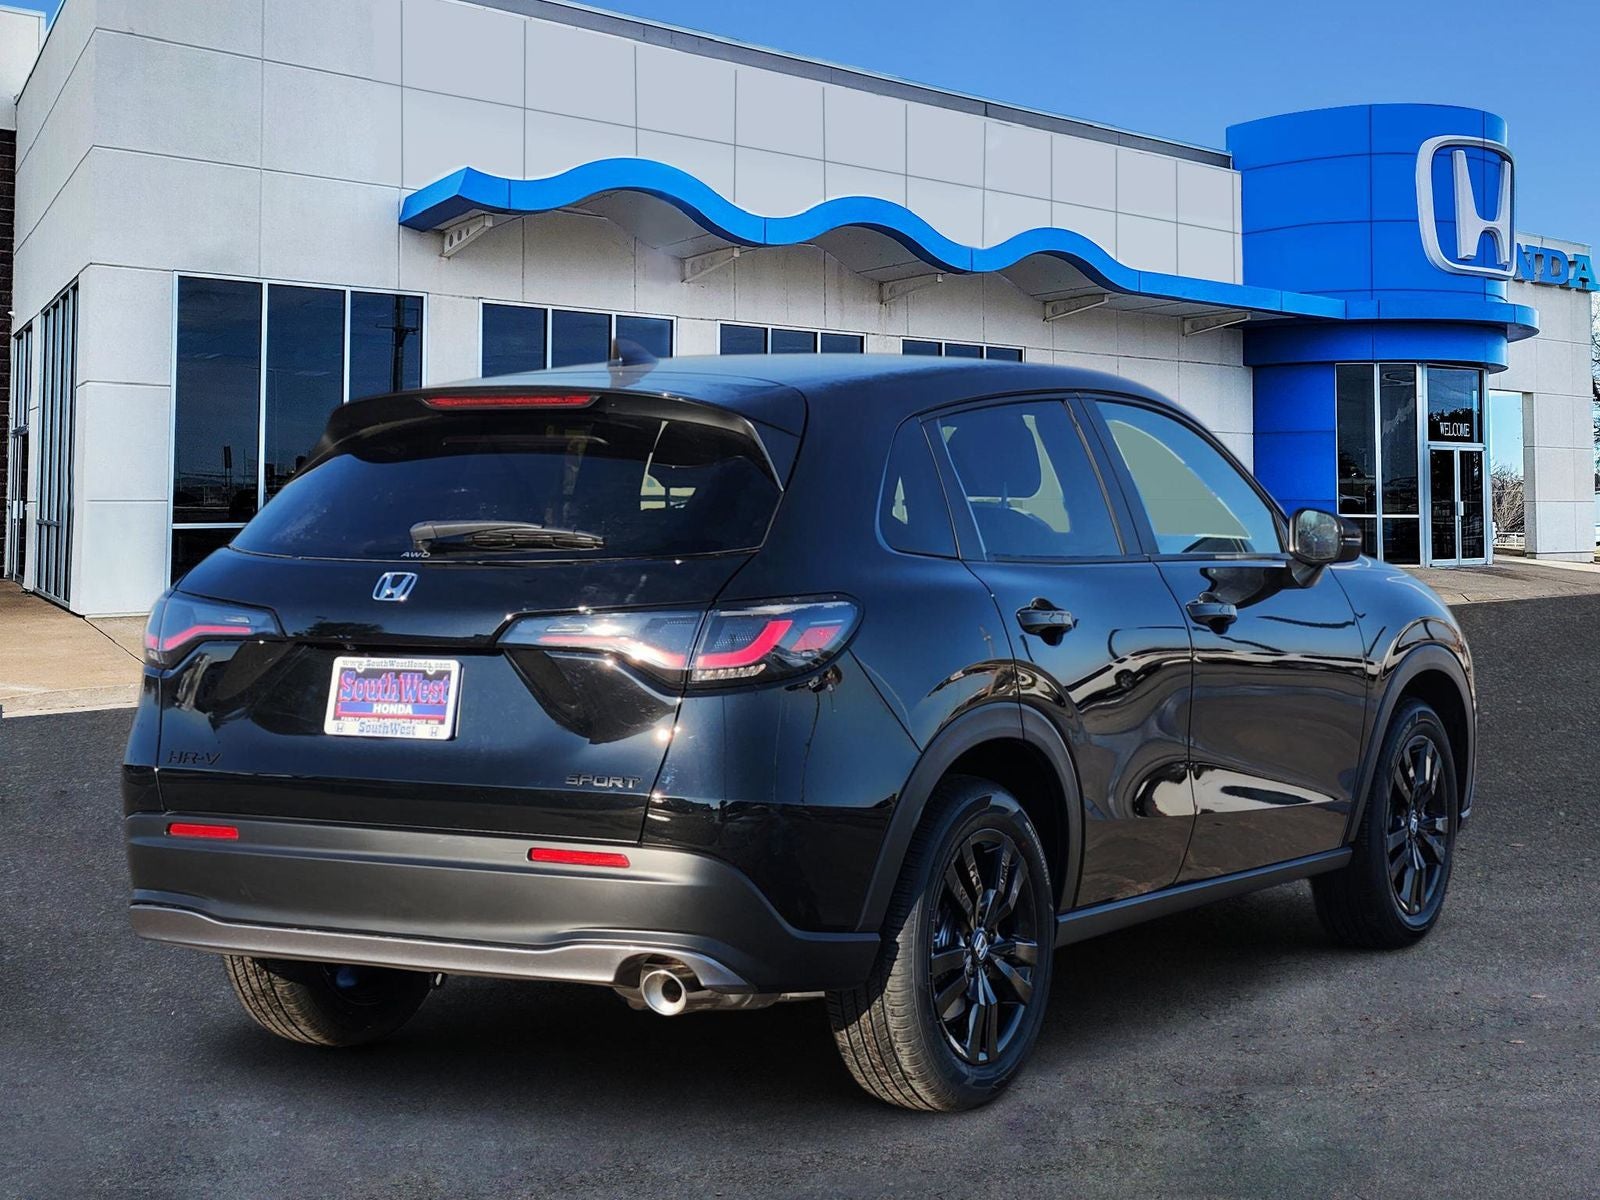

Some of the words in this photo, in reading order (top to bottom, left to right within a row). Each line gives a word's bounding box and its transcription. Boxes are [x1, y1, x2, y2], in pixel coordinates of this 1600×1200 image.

[1440, 422, 1471, 437] WELCOME
[373, 703, 414, 715] HONDA
[168, 750, 222, 765] HR-V
[565, 774, 641, 789] SPORT
